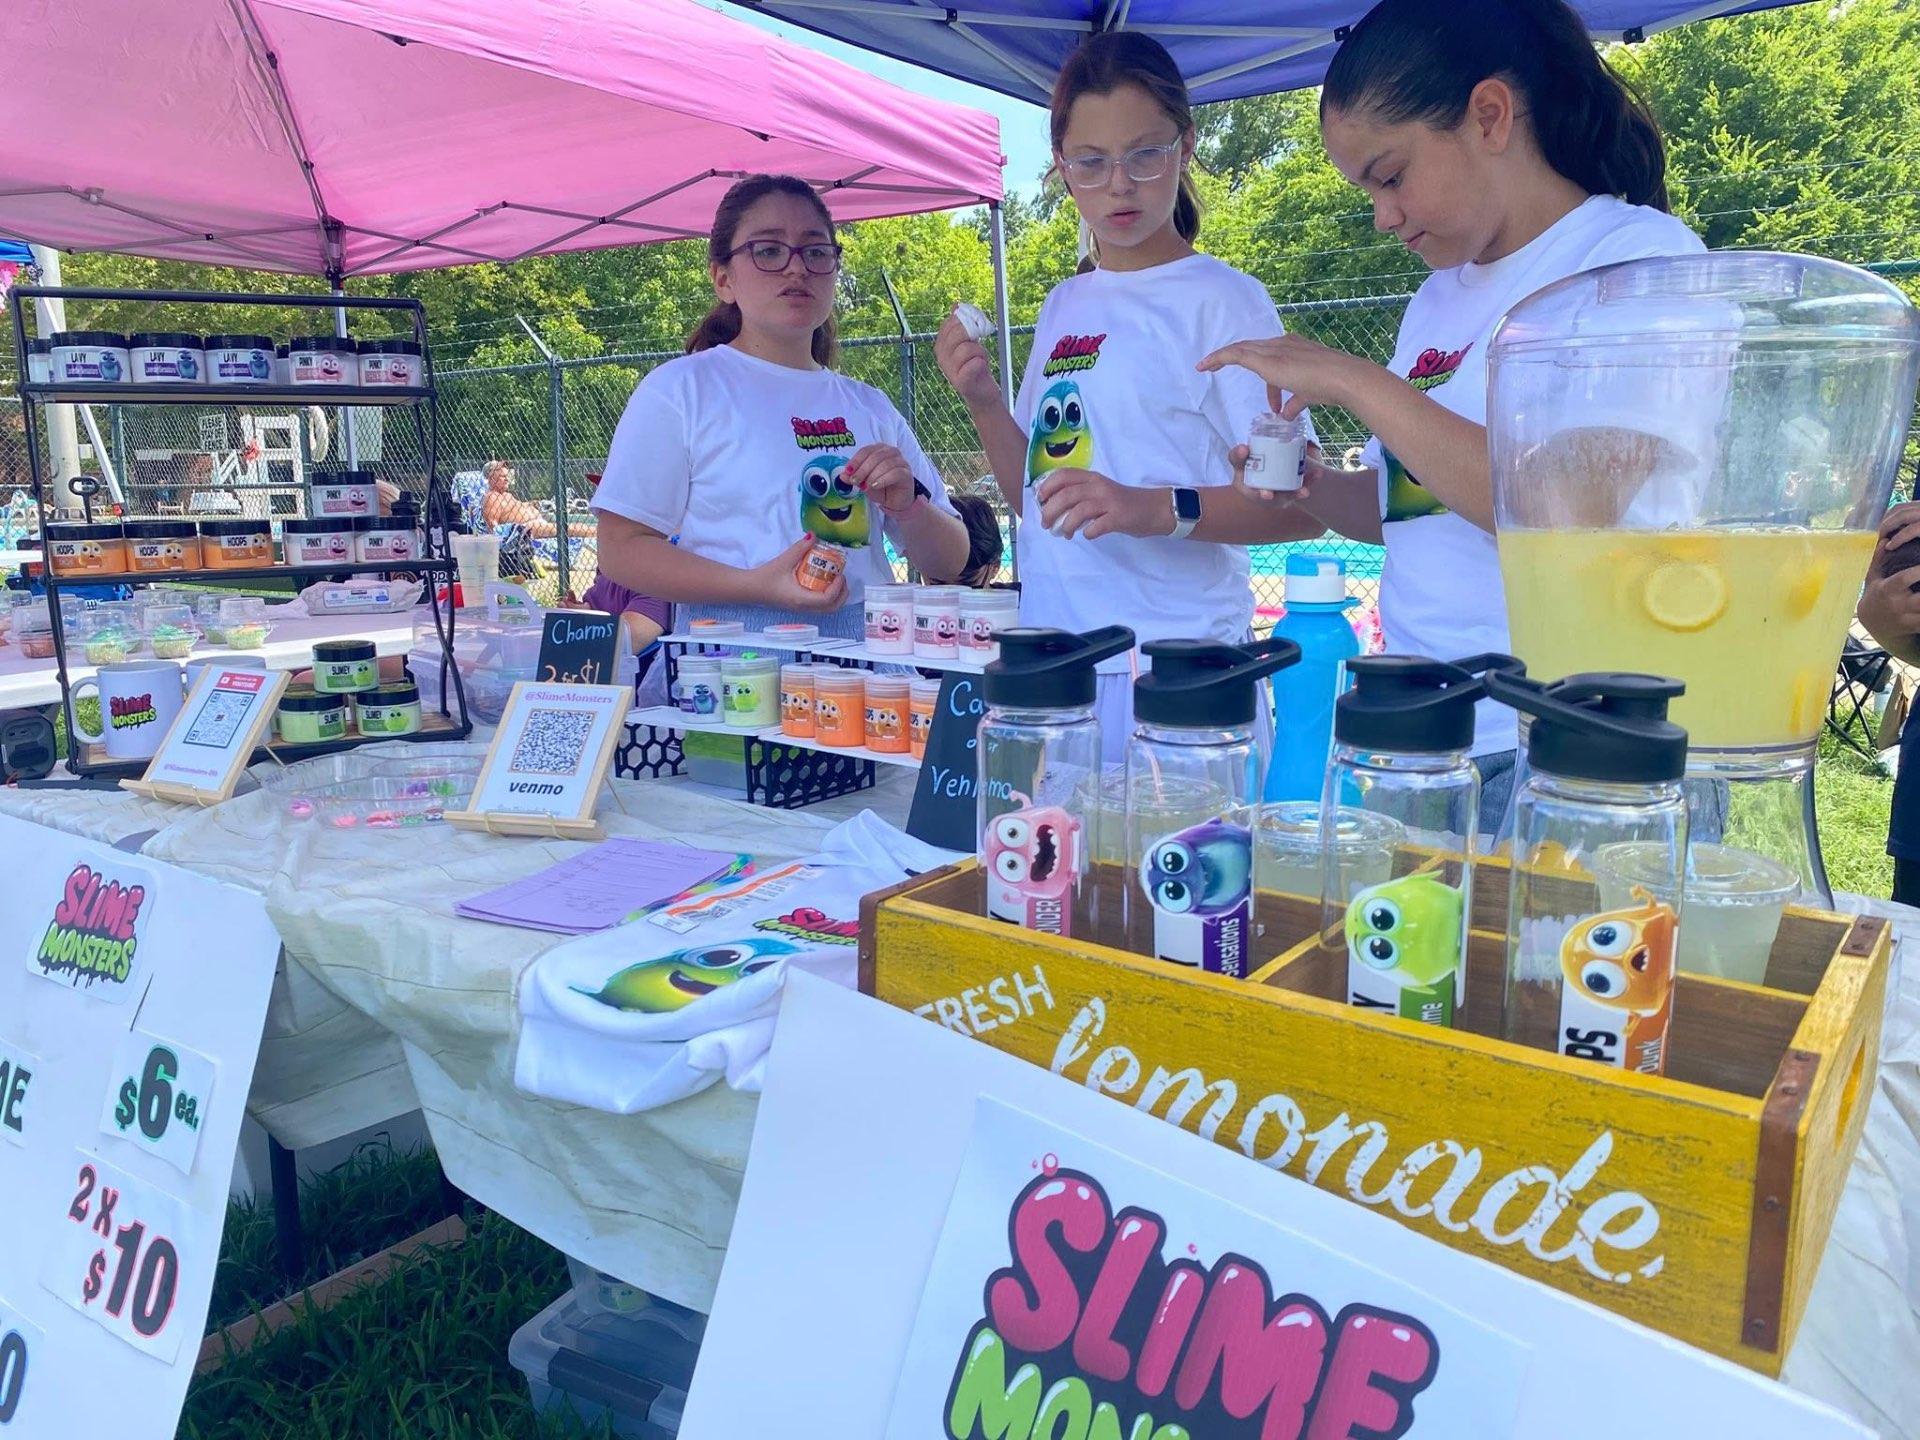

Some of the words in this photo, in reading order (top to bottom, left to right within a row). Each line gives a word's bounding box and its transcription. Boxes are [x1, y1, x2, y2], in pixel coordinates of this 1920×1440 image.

[1043, 351, 1100, 377] MONSTERS
[796, 431, 857, 450] MONSTERS
[326, 489, 341, 500] PINKY
[56, 544, 75, 555] HOOPS
[139, 546, 159, 556] HOOPS
[227, 536, 247, 547] HOOPS
[306, 537, 322, 548] PINKY
[368, 537, 384, 547] PINKY
[811, 554, 828, 570] HOOPS
[552, 619, 615, 646] Charms
[331, 665, 351, 676] SLIMEY
[950, 680, 984, 717] Ca
[111, 708, 157, 729] MONSTERS
[508, 780, 564, 796] venmo
[55, 864, 145, 940] SLIME
[37, 920, 137, 983] MONSTERS
[68, 1163, 97, 1223] 2
[83, 1218, 180, 1338] $10
[985, 1169, 1439, 1440] SLIME
